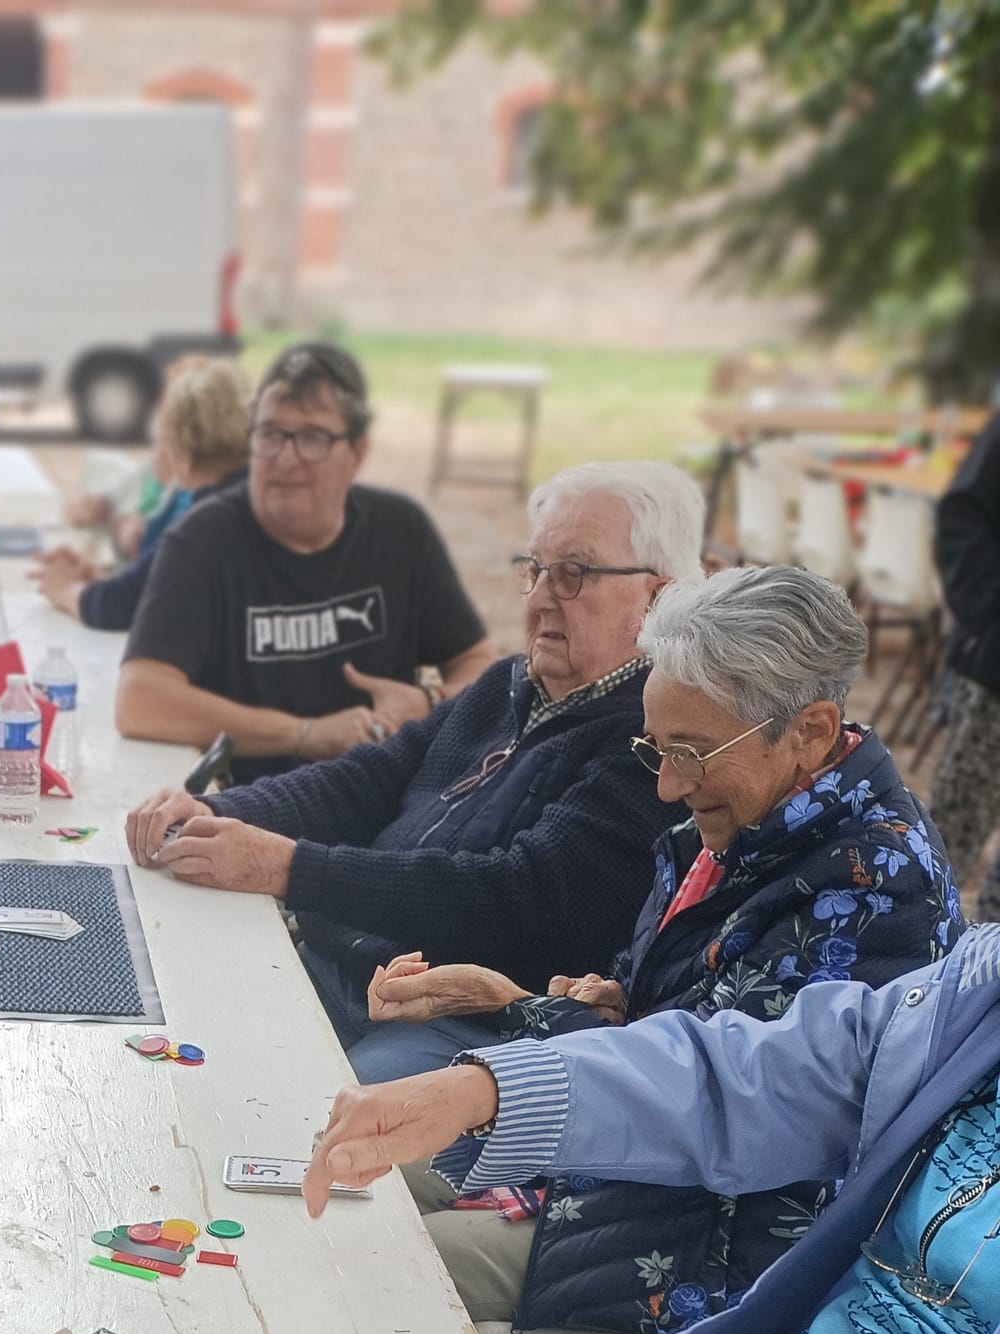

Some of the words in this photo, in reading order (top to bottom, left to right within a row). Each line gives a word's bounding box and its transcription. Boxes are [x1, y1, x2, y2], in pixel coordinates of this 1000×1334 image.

[253, 608, 338, 653] PUMA
[249, 1163, 282, 1177] 51
[137, 1257, 159, 1268] 100
